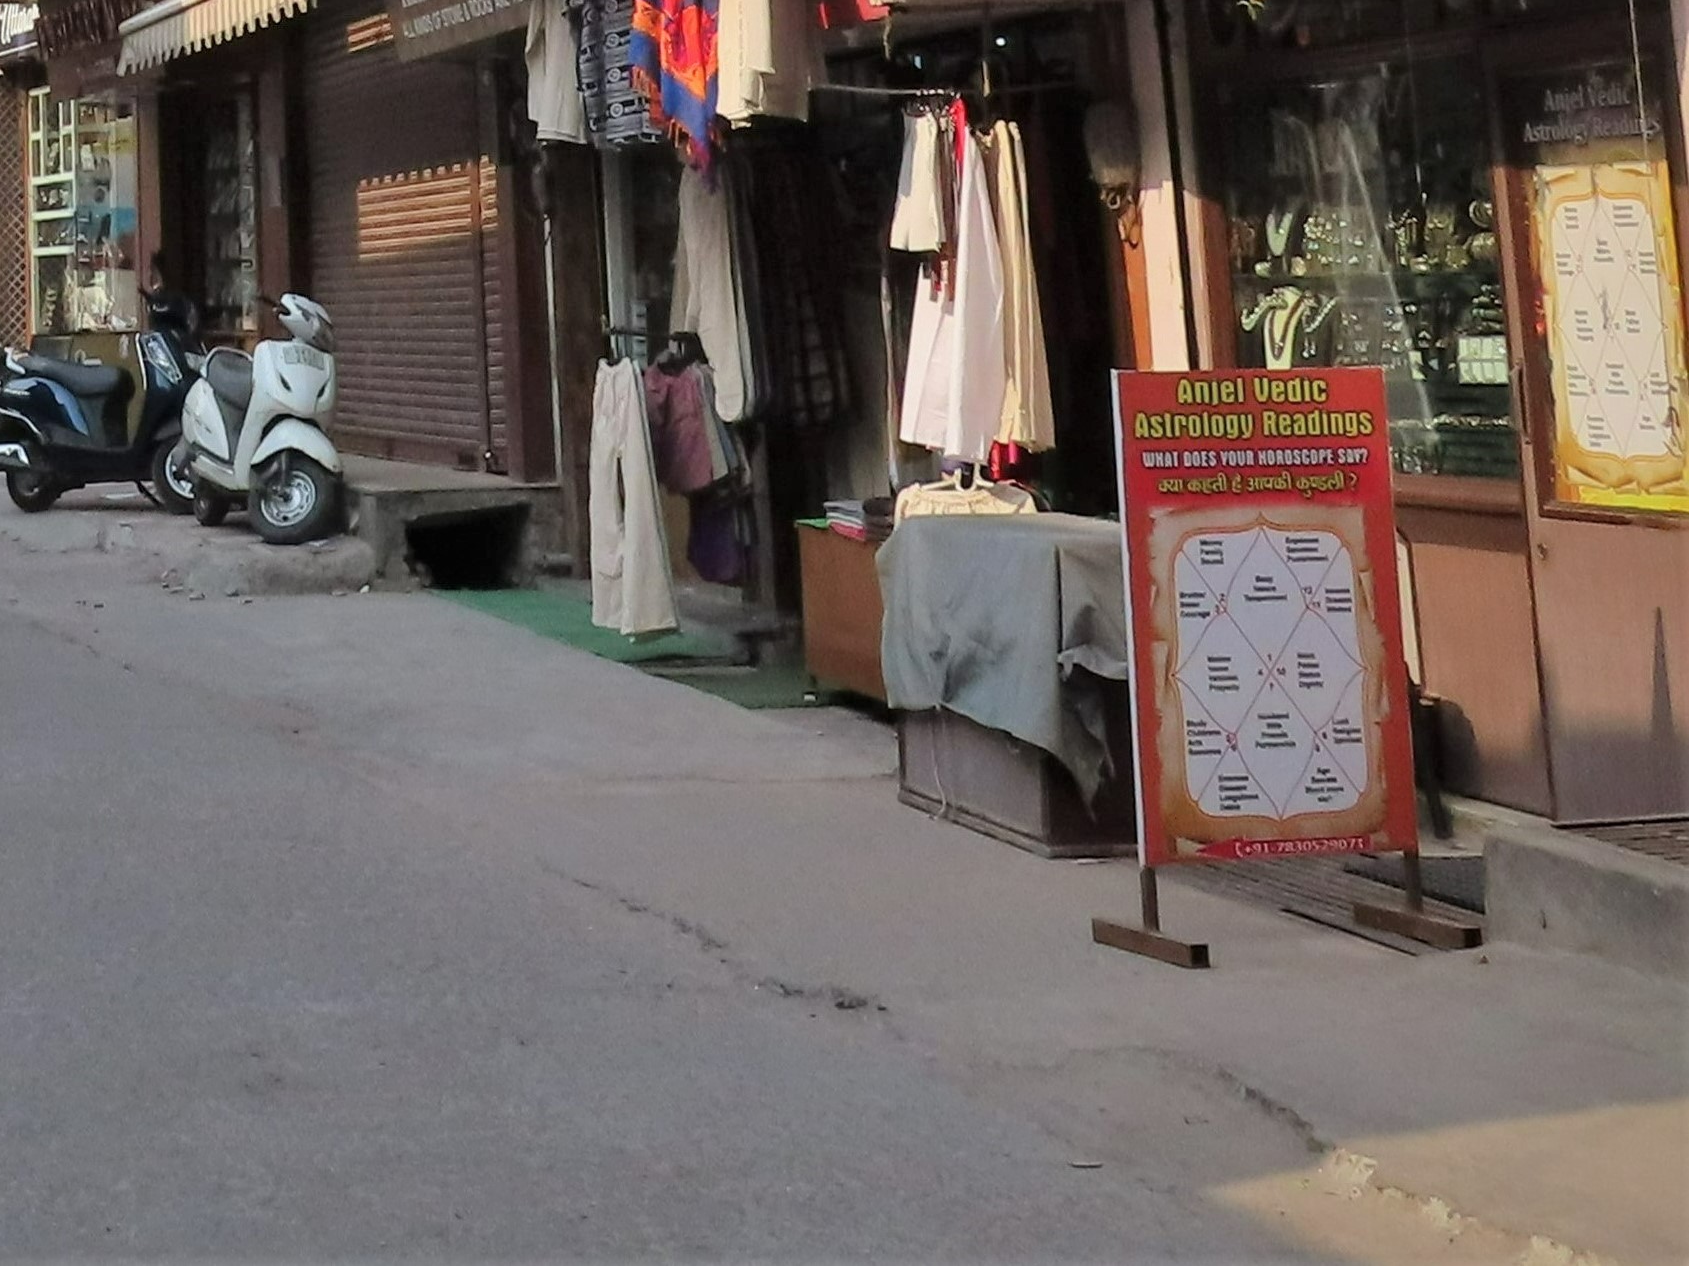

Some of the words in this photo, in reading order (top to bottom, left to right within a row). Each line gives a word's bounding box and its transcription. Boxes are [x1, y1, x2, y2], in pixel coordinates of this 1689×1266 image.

[1523, 118, 1589, 145] Astrology
[1176, 378, 1245, 407] Anjel
[1253, 377, 1327, 403] Vedic
[1134, 411, 1255, 440] Astrology
[1263, 409, 1373, 437] Readings
[1142, 450, 1179, 468] WHAT
[1184, 450, 1217, 467] DOES
[1220, 450, 1255, 467] YOUR
[1258, 449, 1335, 466] HOROSCOPE
[1338, 448, 1370, 465] SAY?
